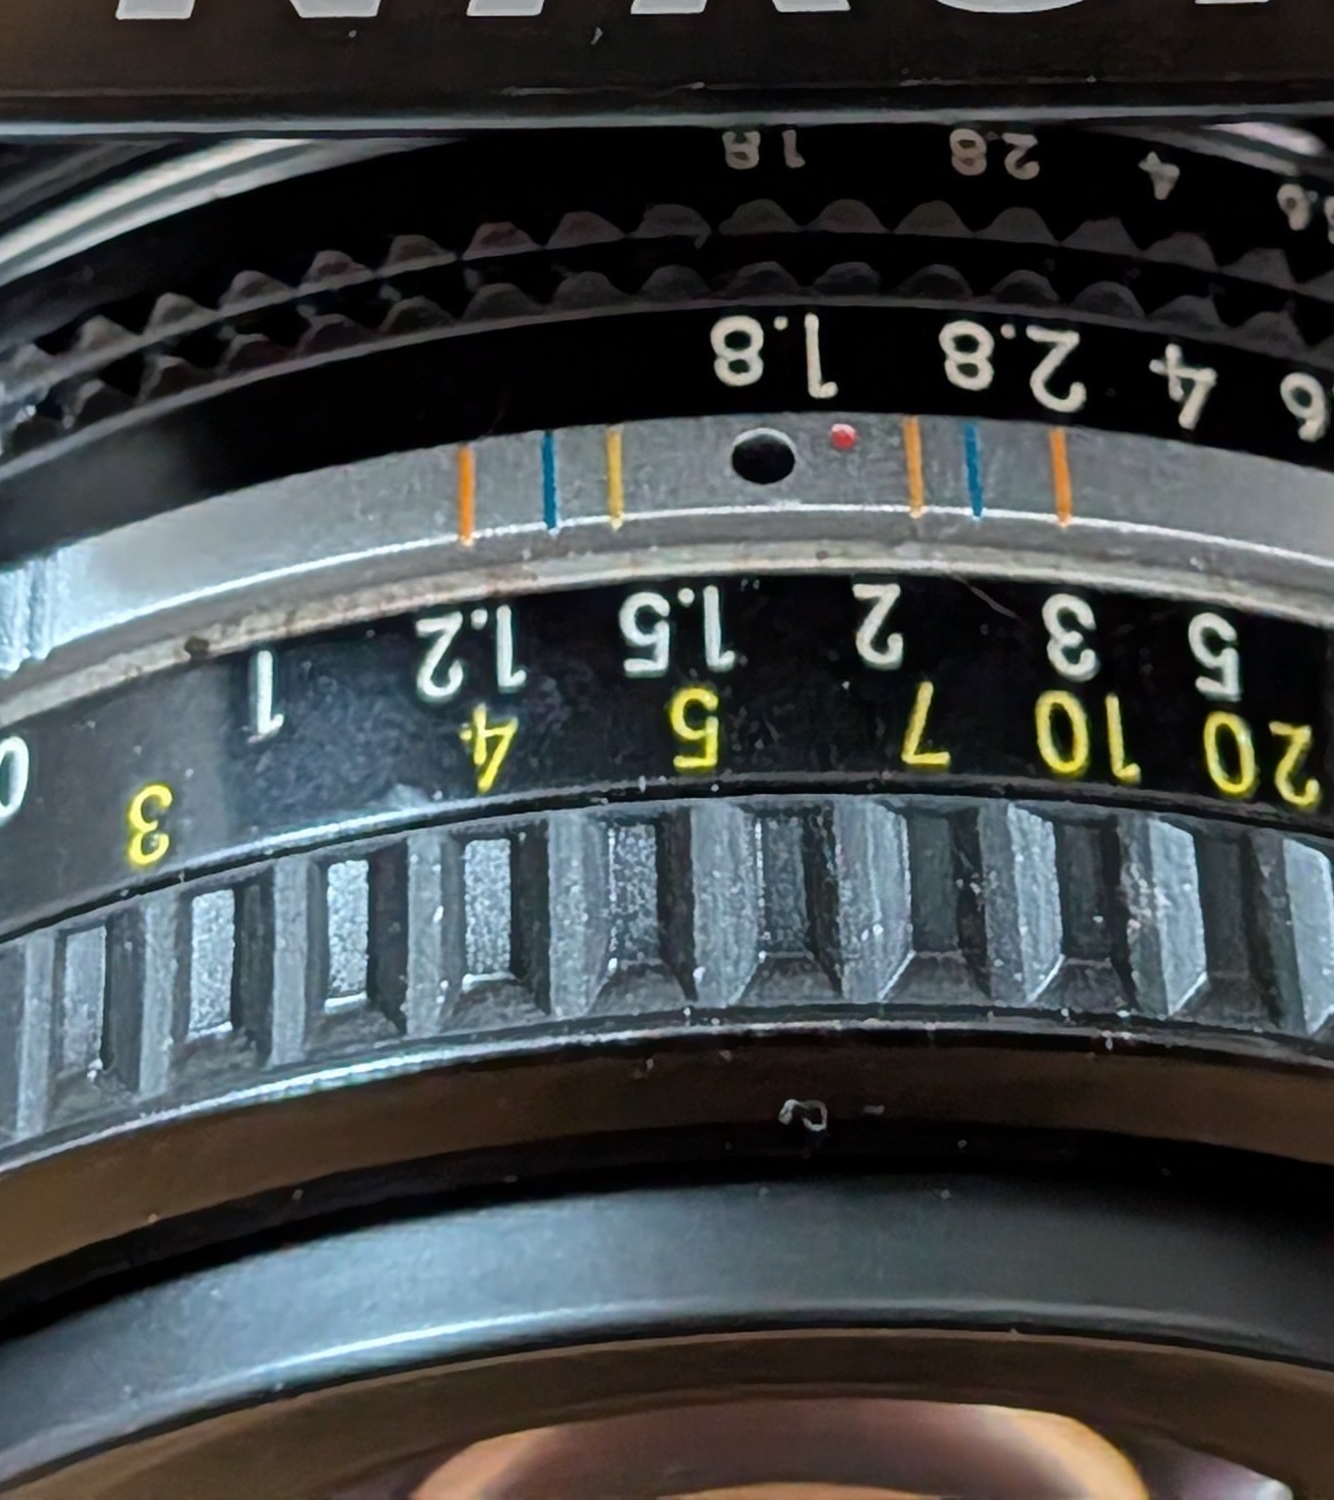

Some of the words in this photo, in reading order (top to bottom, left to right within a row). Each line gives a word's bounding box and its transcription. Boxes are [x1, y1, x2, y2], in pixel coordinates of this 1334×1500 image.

[1138, 151, 1180, 200] 4
[710, 313, 839, 399] 1.8
[938, 319, 1088, 412] 2.8
[1149, 343, 1218, 430] 4
[415, 604, 527, 699] 1.2
[619, 584, 737, 678] 1.5
[852, 583, 904, 668] 2
[1042, 593, 1099, 681] 3
[1187, 612, 1240, 700] 5
[247, 649, 285, 743] 1
[670, 686, 721, 772] 5
[901, 681, 951, 770] 7
[1034, 690, 1141, 783] 10
[460, 702, 519, 793] 4
[1203, 710, 1321, 808] 20
[127, 784, 175, 868] 3
